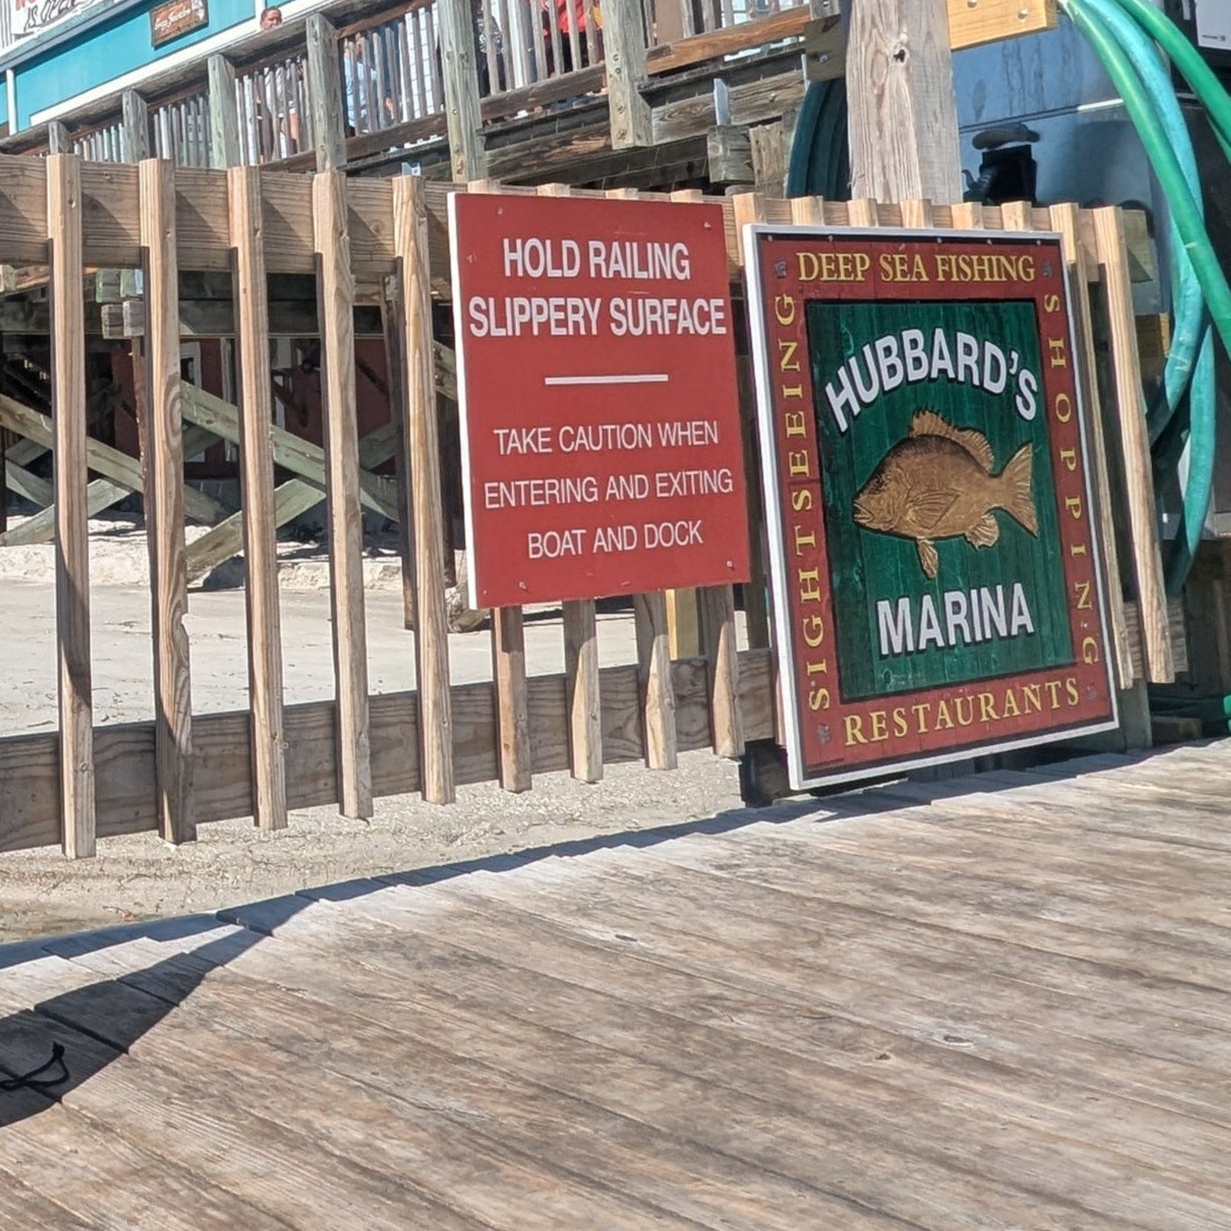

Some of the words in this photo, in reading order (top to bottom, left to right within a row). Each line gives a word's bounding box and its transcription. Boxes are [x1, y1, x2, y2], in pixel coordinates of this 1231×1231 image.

[24, 4, 42, 32] IS
[503, 238, 580, 279] HOLD
[589, 240, 691, 280] RAILING
[797, 252, 871, 283] DEEP
[880, 253, 929, 282] SEA
[935, 253, 1036, 282] FISHING
[469, 296, 601, 337] SLIPPERY
[610, 297, 727, 336] SURFACE
[825, 327, 1039, 433] HUBBARD'S
[493, 427, 552, 456] TAKE
[558, 423, 653, 452] CAUTION
[658, 420, 719, 447] WHEN
[484, 478, 598, 509] ENTERING
[605, 473, 649, 502] AND
[655, 468, 734, 498] EXITING
[1043, 293, 1100, 666] SHOPPING
[773, 292, 831, 712] SIGHTSEEING
[527, 529, 586, 559] BOAT
[592, 525, 638, 554] AND
[644, 520, 704, 549] DOCK
[876, 582, 1036, 656] MARINA
[843, 677, 1081, 747] RESTAURANTS
